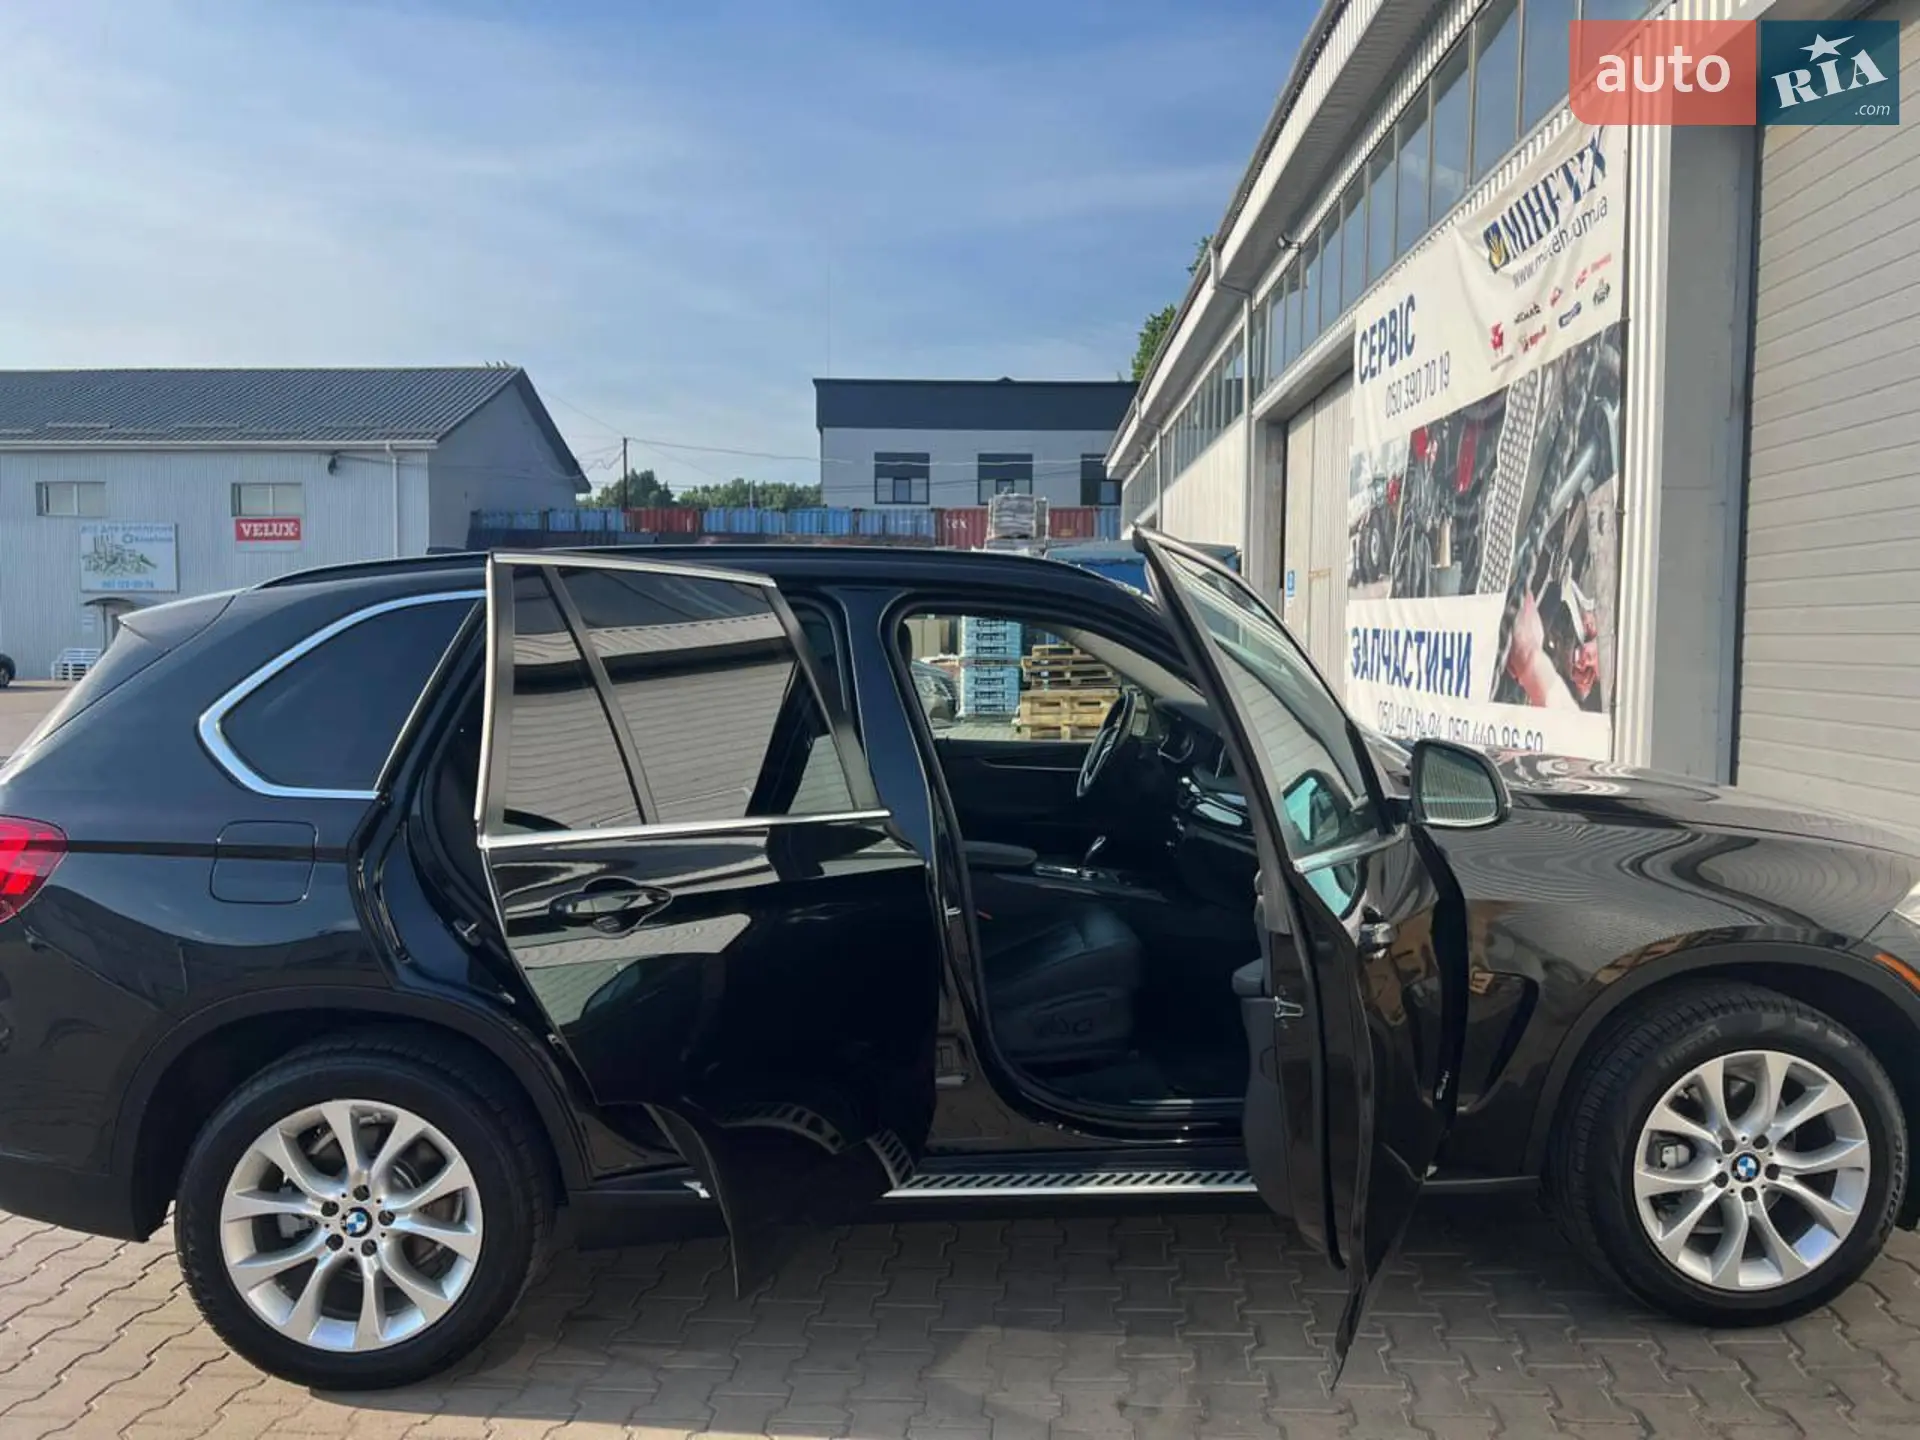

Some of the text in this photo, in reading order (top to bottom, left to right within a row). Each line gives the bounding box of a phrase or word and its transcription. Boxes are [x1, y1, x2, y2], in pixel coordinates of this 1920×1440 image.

[1359, 293, 1416, 384] СЕРВІС
[240, 522, 296, 537] VELUX
[1351, 626, 1472, 699] ЗАПЧАСТИНИ
